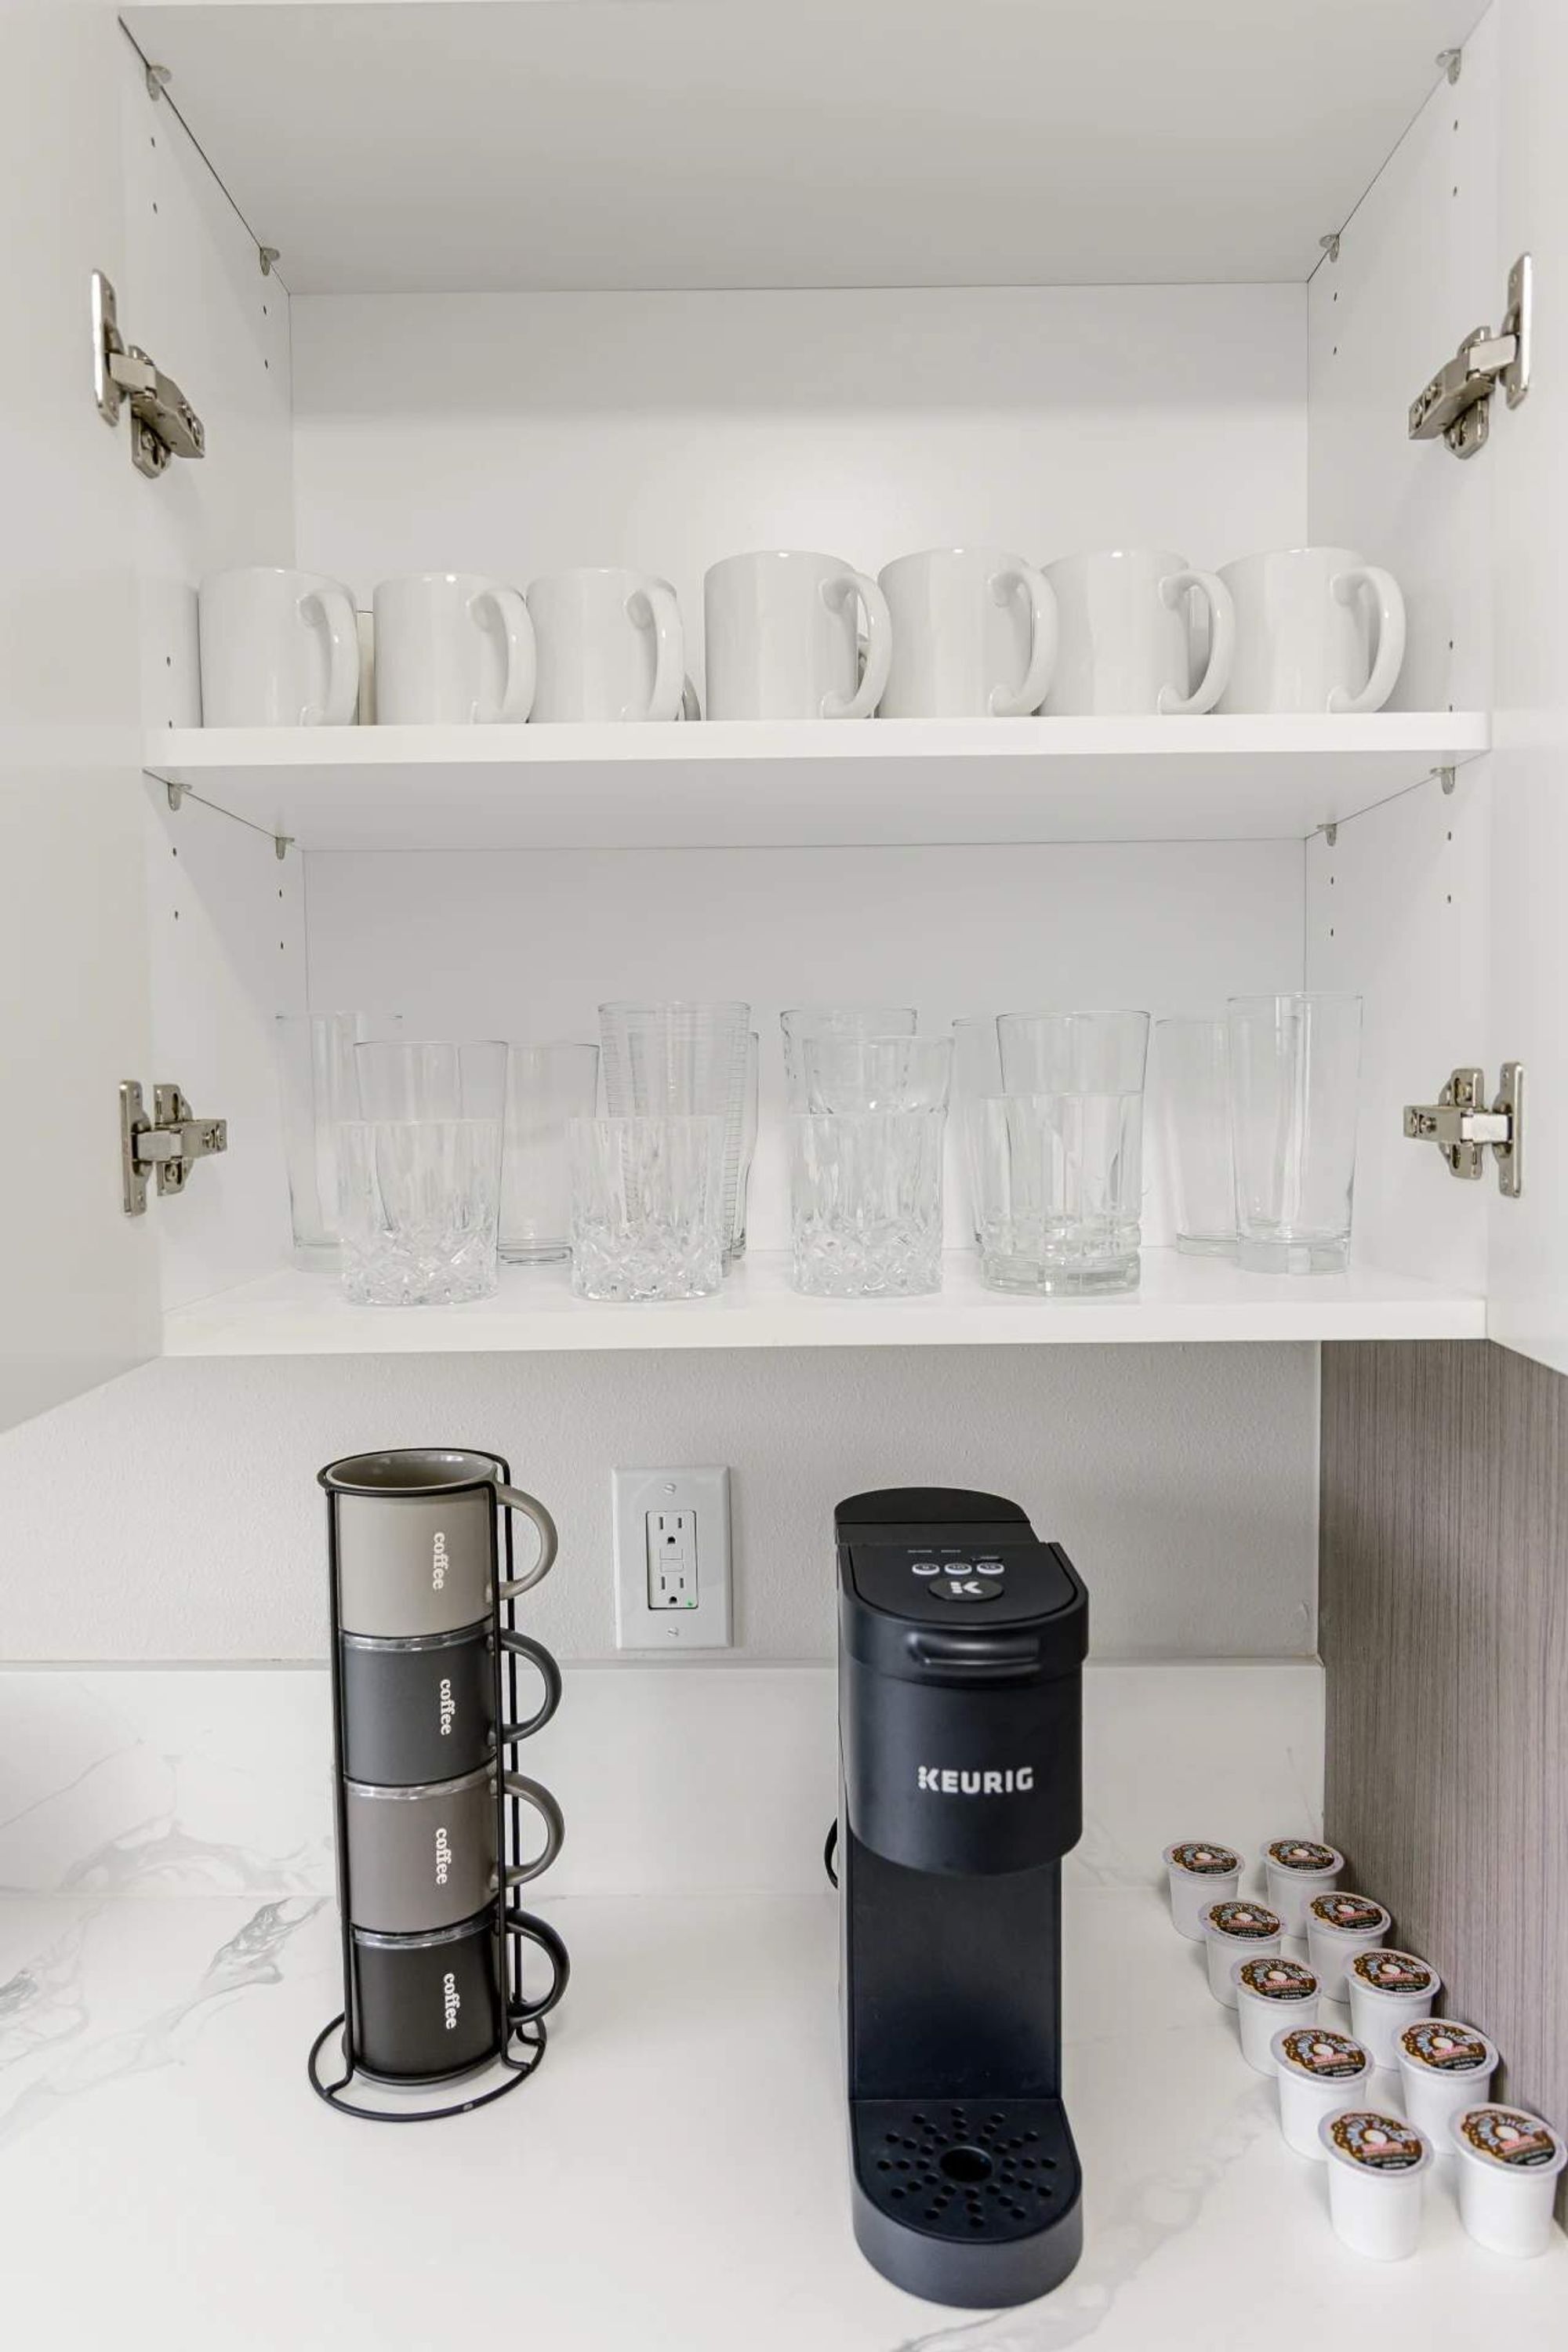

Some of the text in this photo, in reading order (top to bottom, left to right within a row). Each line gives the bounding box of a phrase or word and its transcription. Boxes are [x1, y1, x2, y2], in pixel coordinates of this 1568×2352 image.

[433, 1532, 448, 1590] coffee
[950, 1581, 983, 1594] K
[440, 1679, 456, 1736] coffee
[918, 1766, 1033, 1794] KEURIG
[436, 1828, 452, 1885] coffee
[444, 1973, 460, 2030] coffee
